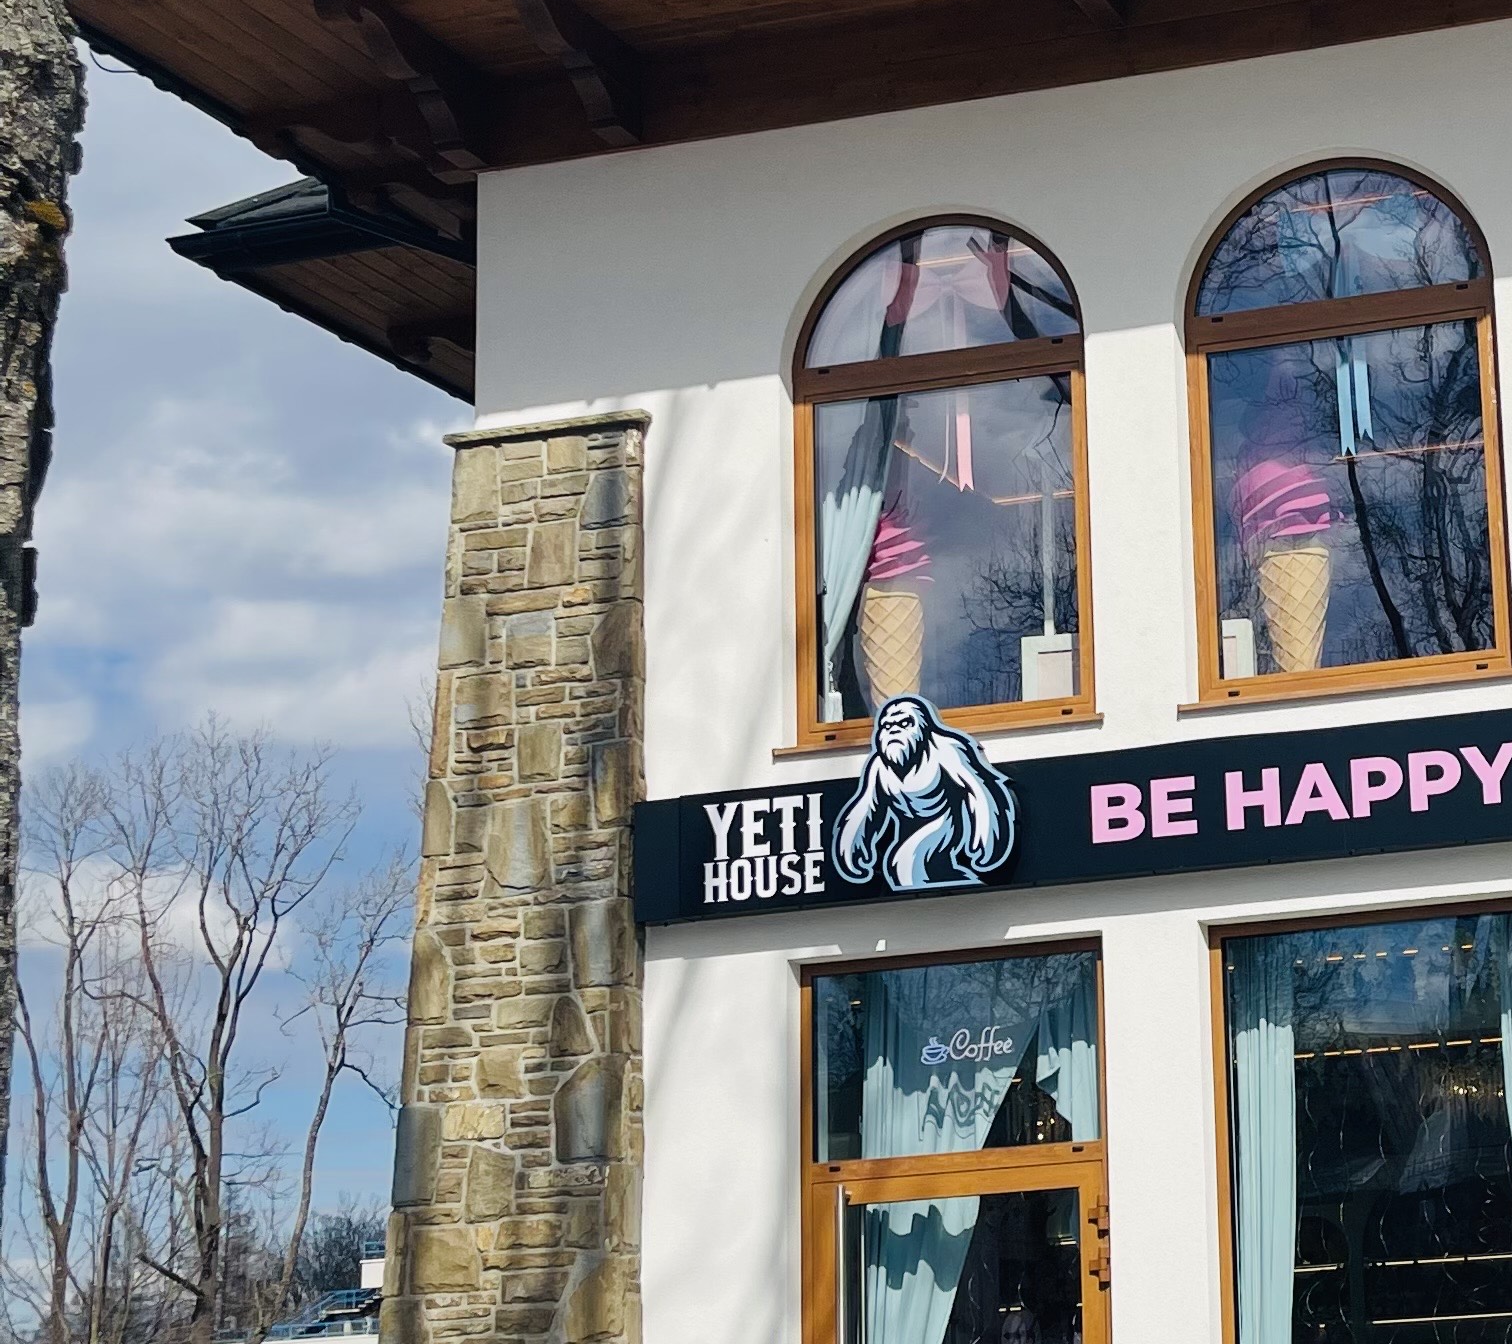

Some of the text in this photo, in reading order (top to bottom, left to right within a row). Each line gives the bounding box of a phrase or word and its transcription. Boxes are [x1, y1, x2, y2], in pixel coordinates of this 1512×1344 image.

[702, 792, 824, 861] YETI
[1090, 775, 1199, 844] BE
[702, 851, 826, 904] HOUSE
[949, 1025, 1014, 1062] Coffee
